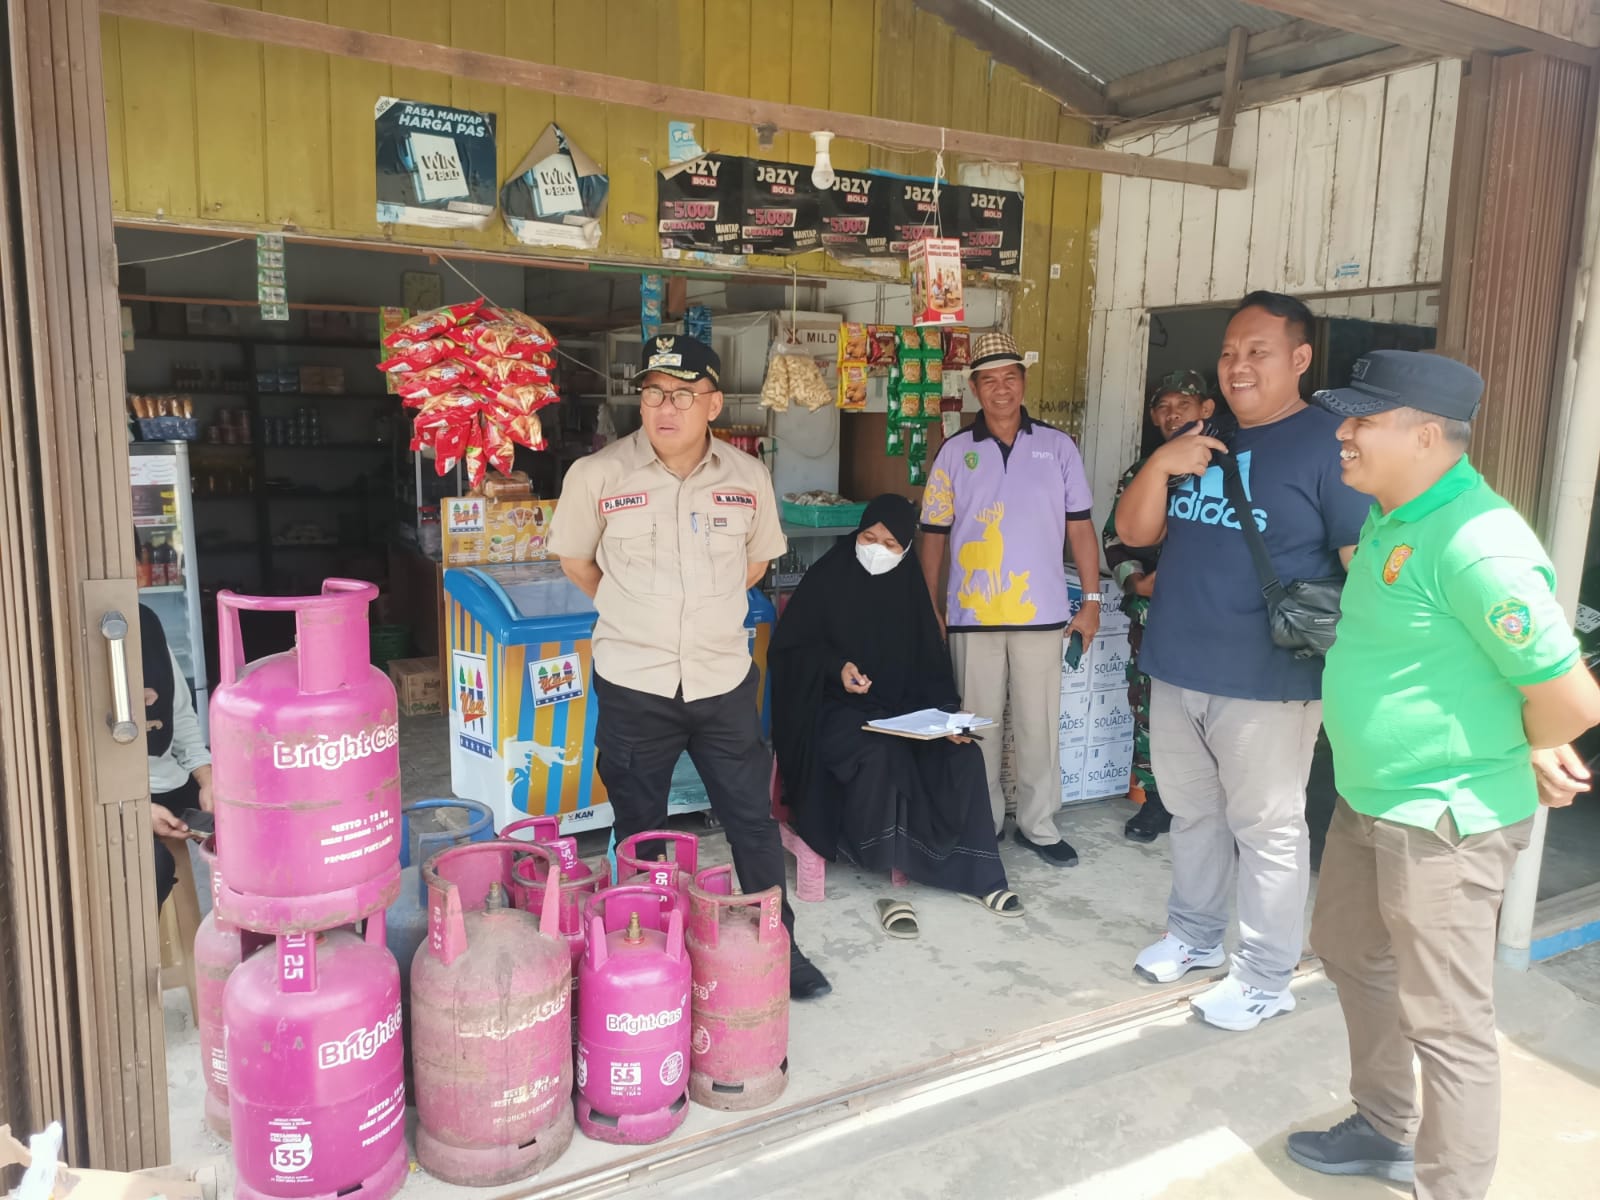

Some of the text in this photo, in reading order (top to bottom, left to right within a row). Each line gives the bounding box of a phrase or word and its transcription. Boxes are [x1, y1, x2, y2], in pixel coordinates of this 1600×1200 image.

[404, 104, 483, 125] RASA MANTAP
[399, 114, 486, 138] HARGA PAS
[692, 177, 717, 187] BOLD
[772, 185, 795, 195] BOLD
[846, 194, 868, 204] BOLD
[983, 209, 1002, 219] BOLD
[807, 332, 837, 345] MILD
[615, 496, 643, 507] BUPATI
[575, 810, 594, 820] KAN
[283, 954, 305, 980] 25
[272, 1149, 306, 1167] 135
